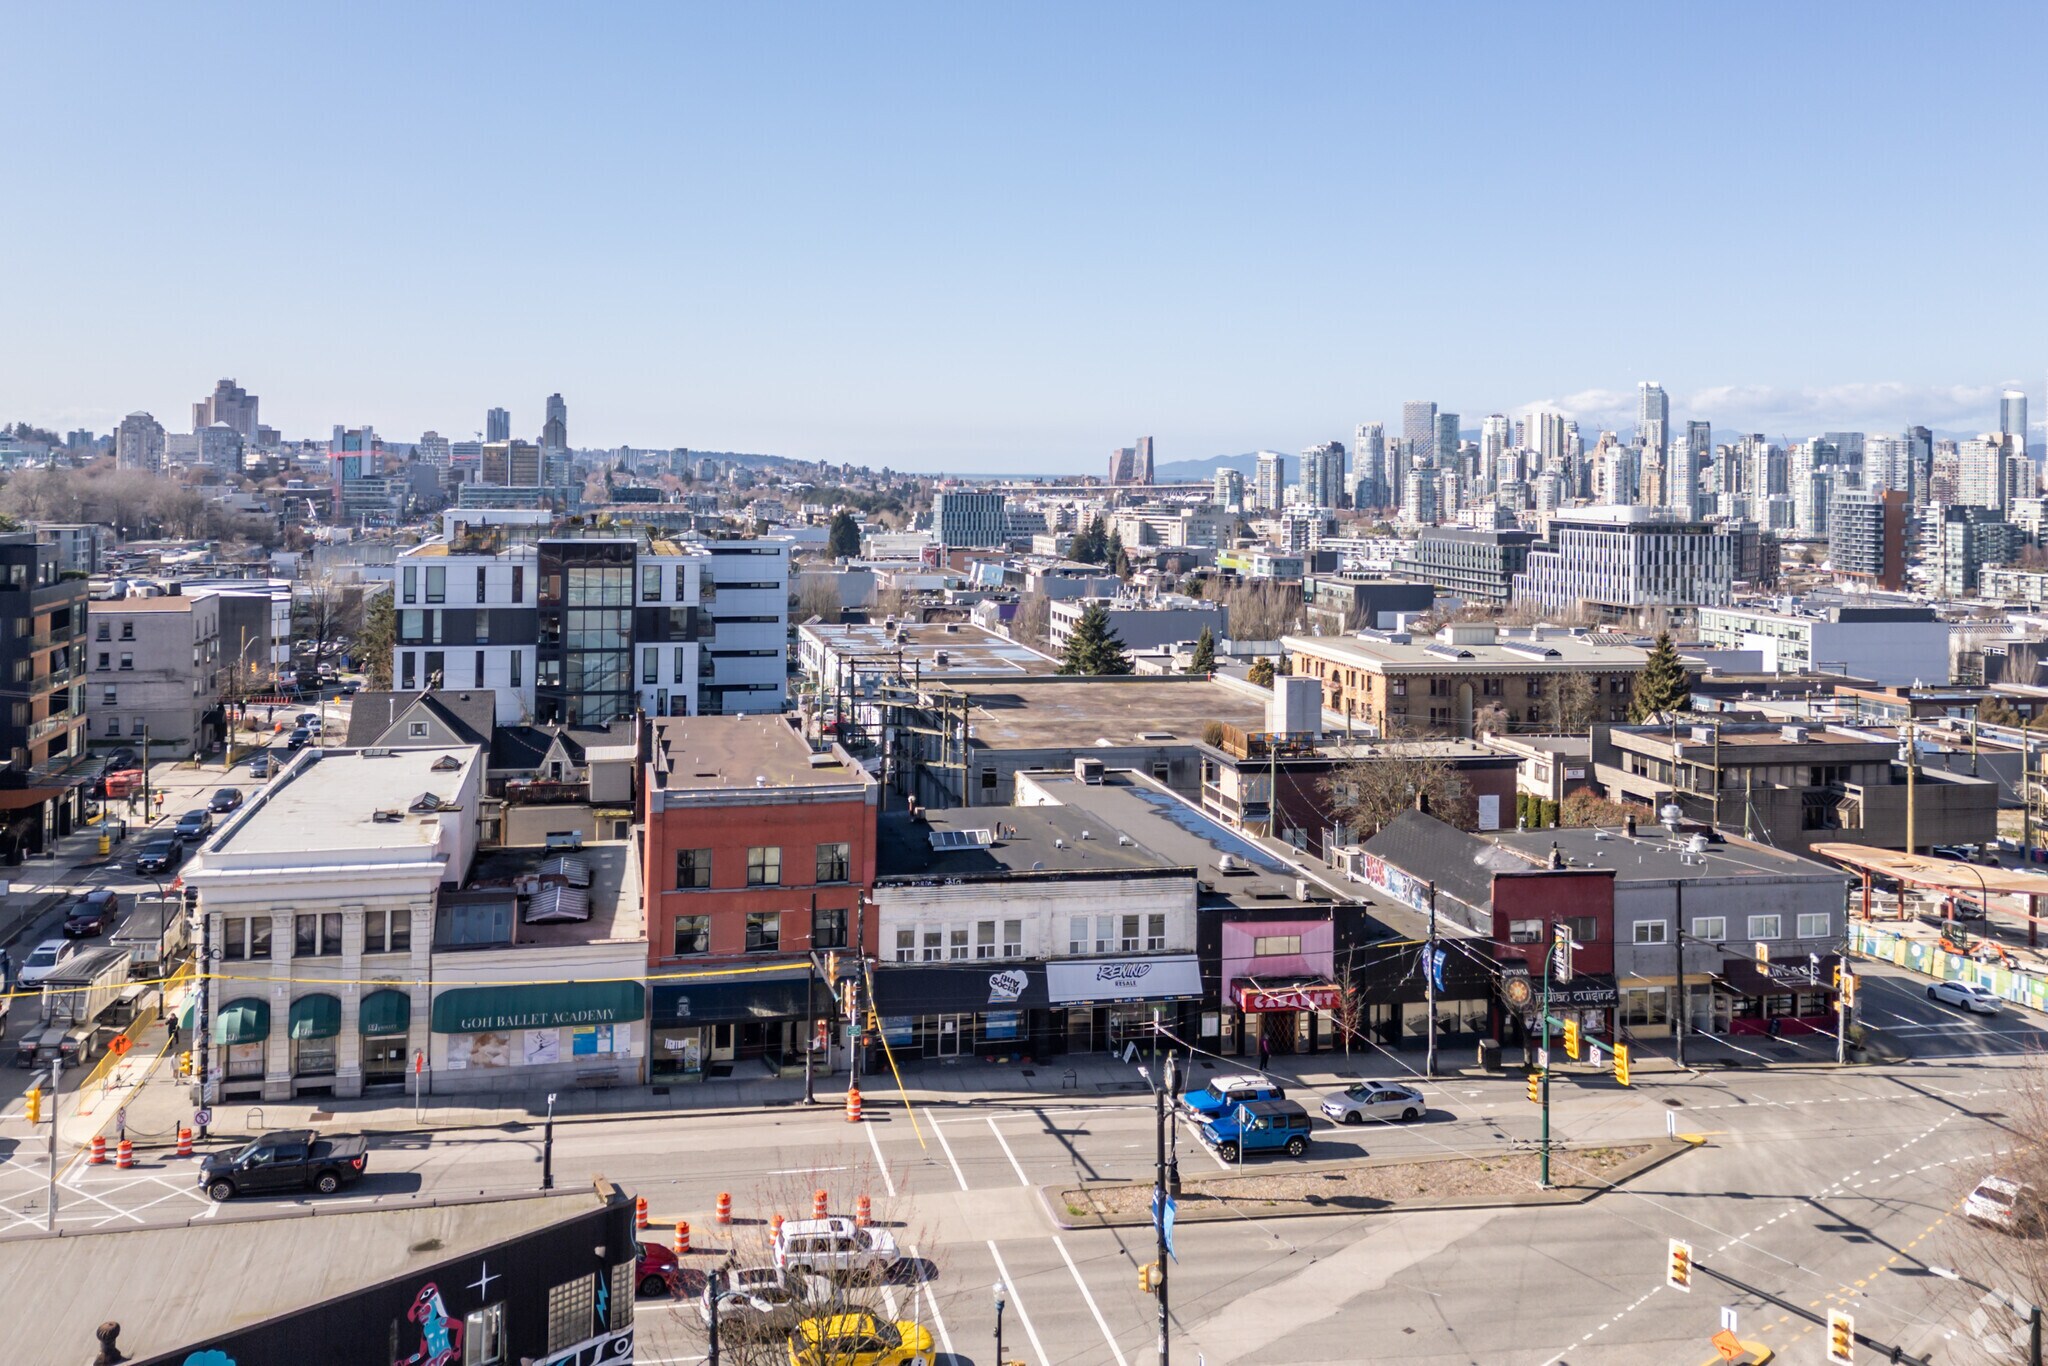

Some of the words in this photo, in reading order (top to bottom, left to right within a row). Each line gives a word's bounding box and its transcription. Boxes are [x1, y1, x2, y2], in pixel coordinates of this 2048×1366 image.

[1097, 963, 1152, 981] REWIND
[990, 976, 1019, 995] Social
[1254, 992, 1335, 1010] CABARET
[461, 1016, 492, 1029] GOH
[496, 1012, 548, 1028] BALLET
[551, 1008, 616, 1024] ACADEMY
